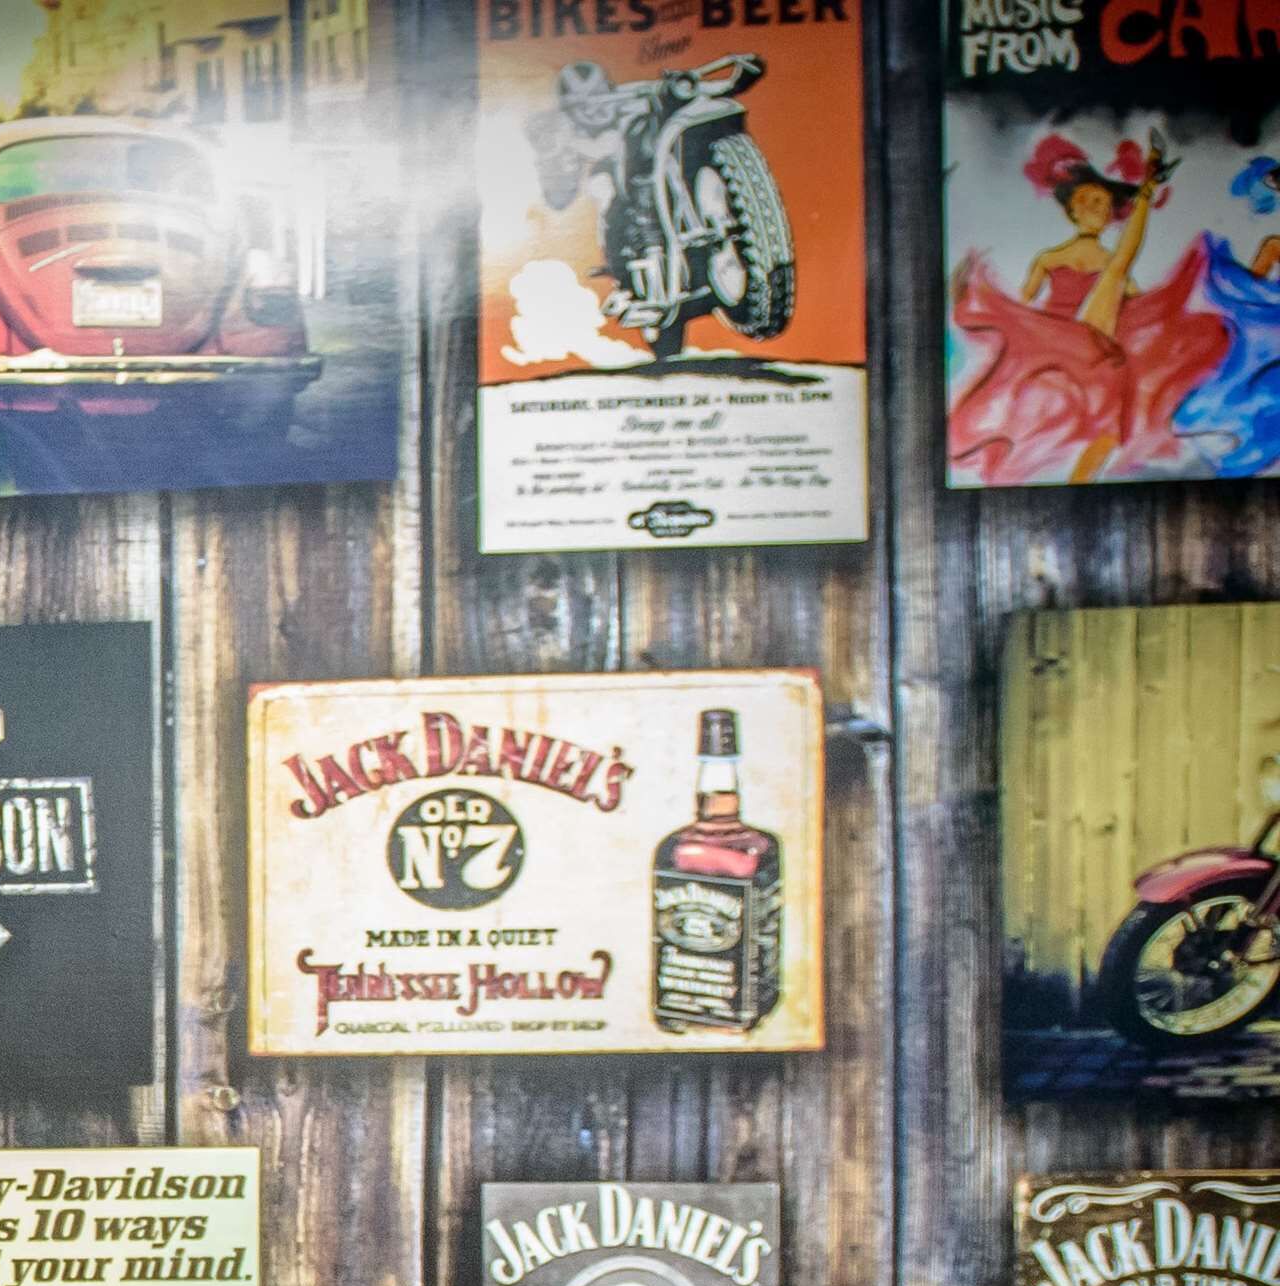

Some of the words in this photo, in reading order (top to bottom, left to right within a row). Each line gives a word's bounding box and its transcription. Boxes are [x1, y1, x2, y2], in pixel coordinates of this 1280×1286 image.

[488, 0, 655, 40] BIKES
[961, 28, 1081, 78] FROM
[282, 728, 417, 819] JACK
[421, 711, 635, 813] DANIEL'S
[366, 930, 430, 947] MADE
[437, 929, 465, 947] IN
[467, 929, 482, 946] A
[487, 928, 558, 949] QUIET
[26, 1206, 85, 1242] 10
[93, 1211, 207, 1251] ways
[485, 1200, 599, 1286] JACK
[120, 1246, 254, 1284] mind.
